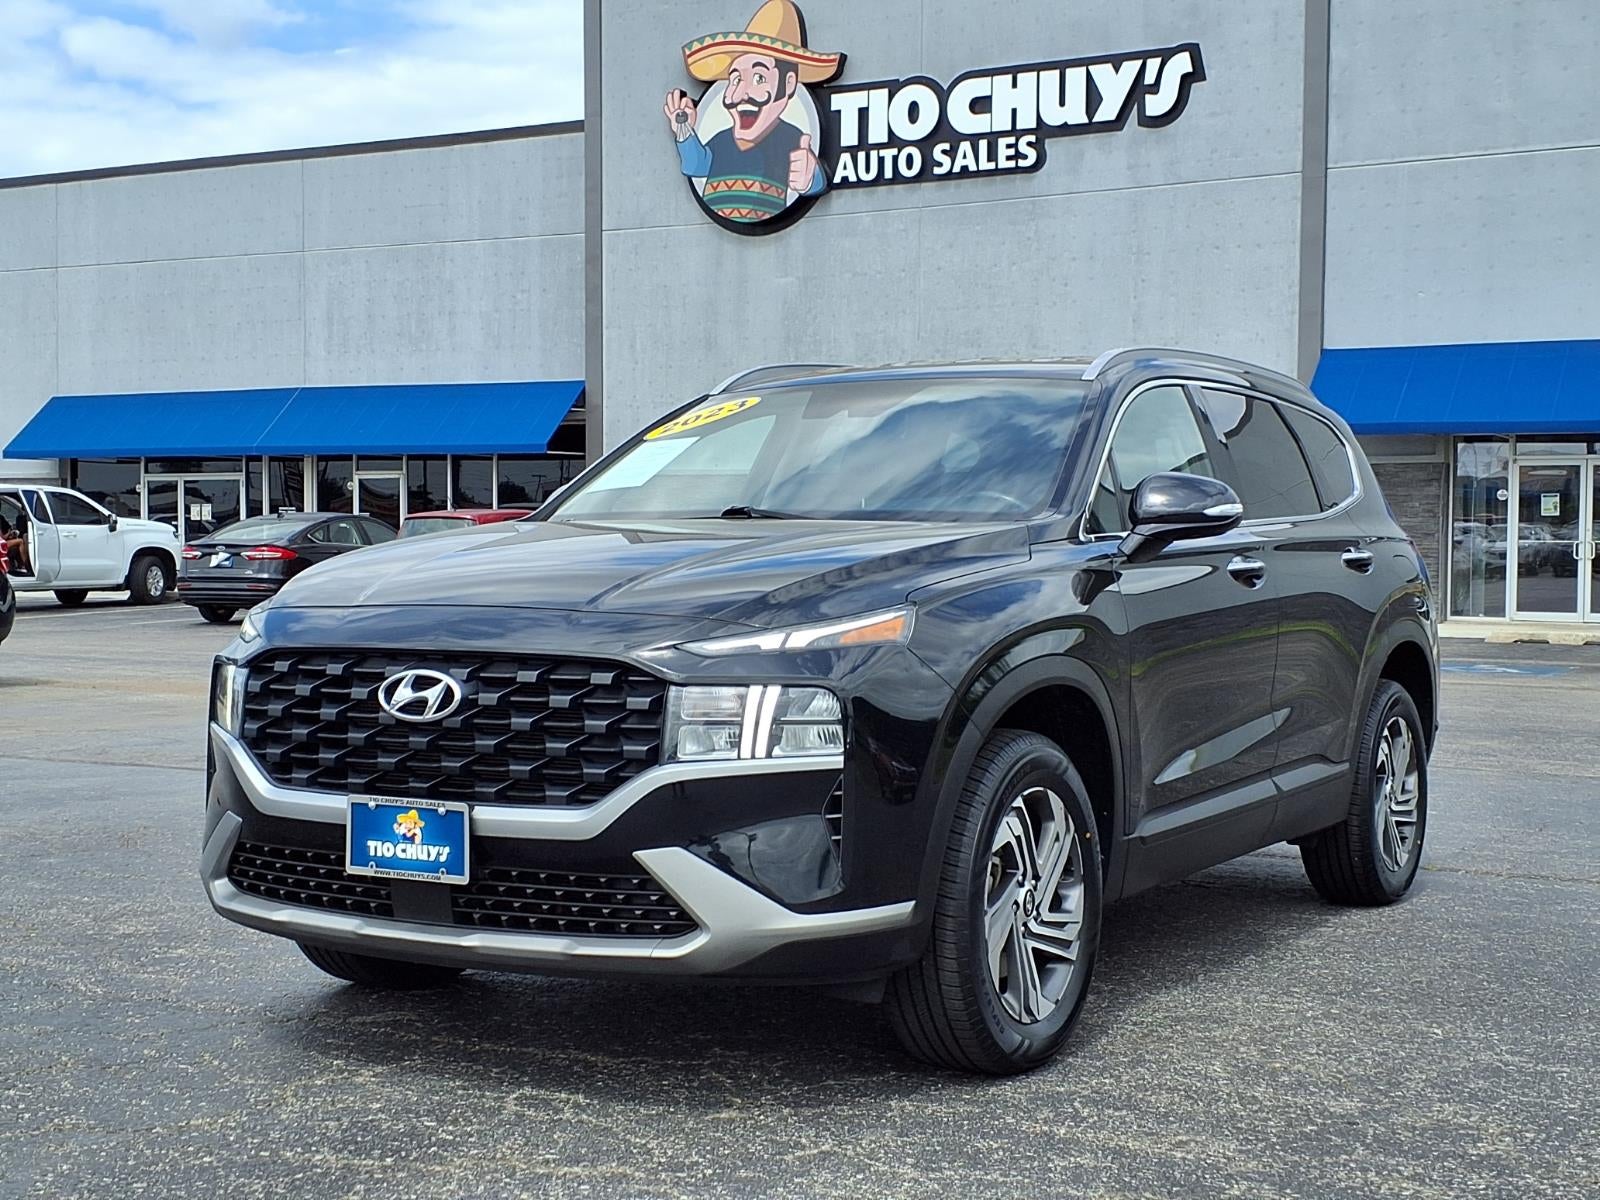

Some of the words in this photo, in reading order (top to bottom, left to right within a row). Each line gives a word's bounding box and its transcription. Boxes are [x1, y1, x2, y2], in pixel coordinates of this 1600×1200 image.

[830, 84, 940, 147] TIO
[947, 51, 1193, 134] CHUY'S
[833, 146, 922, 183] AUTO
[932, 135, 1037, 175] SALES
[660, 400, 748, 432] 2023
[367, 840, 395, 858] TIO
[395, 843, 450, 862] CHUY'S
